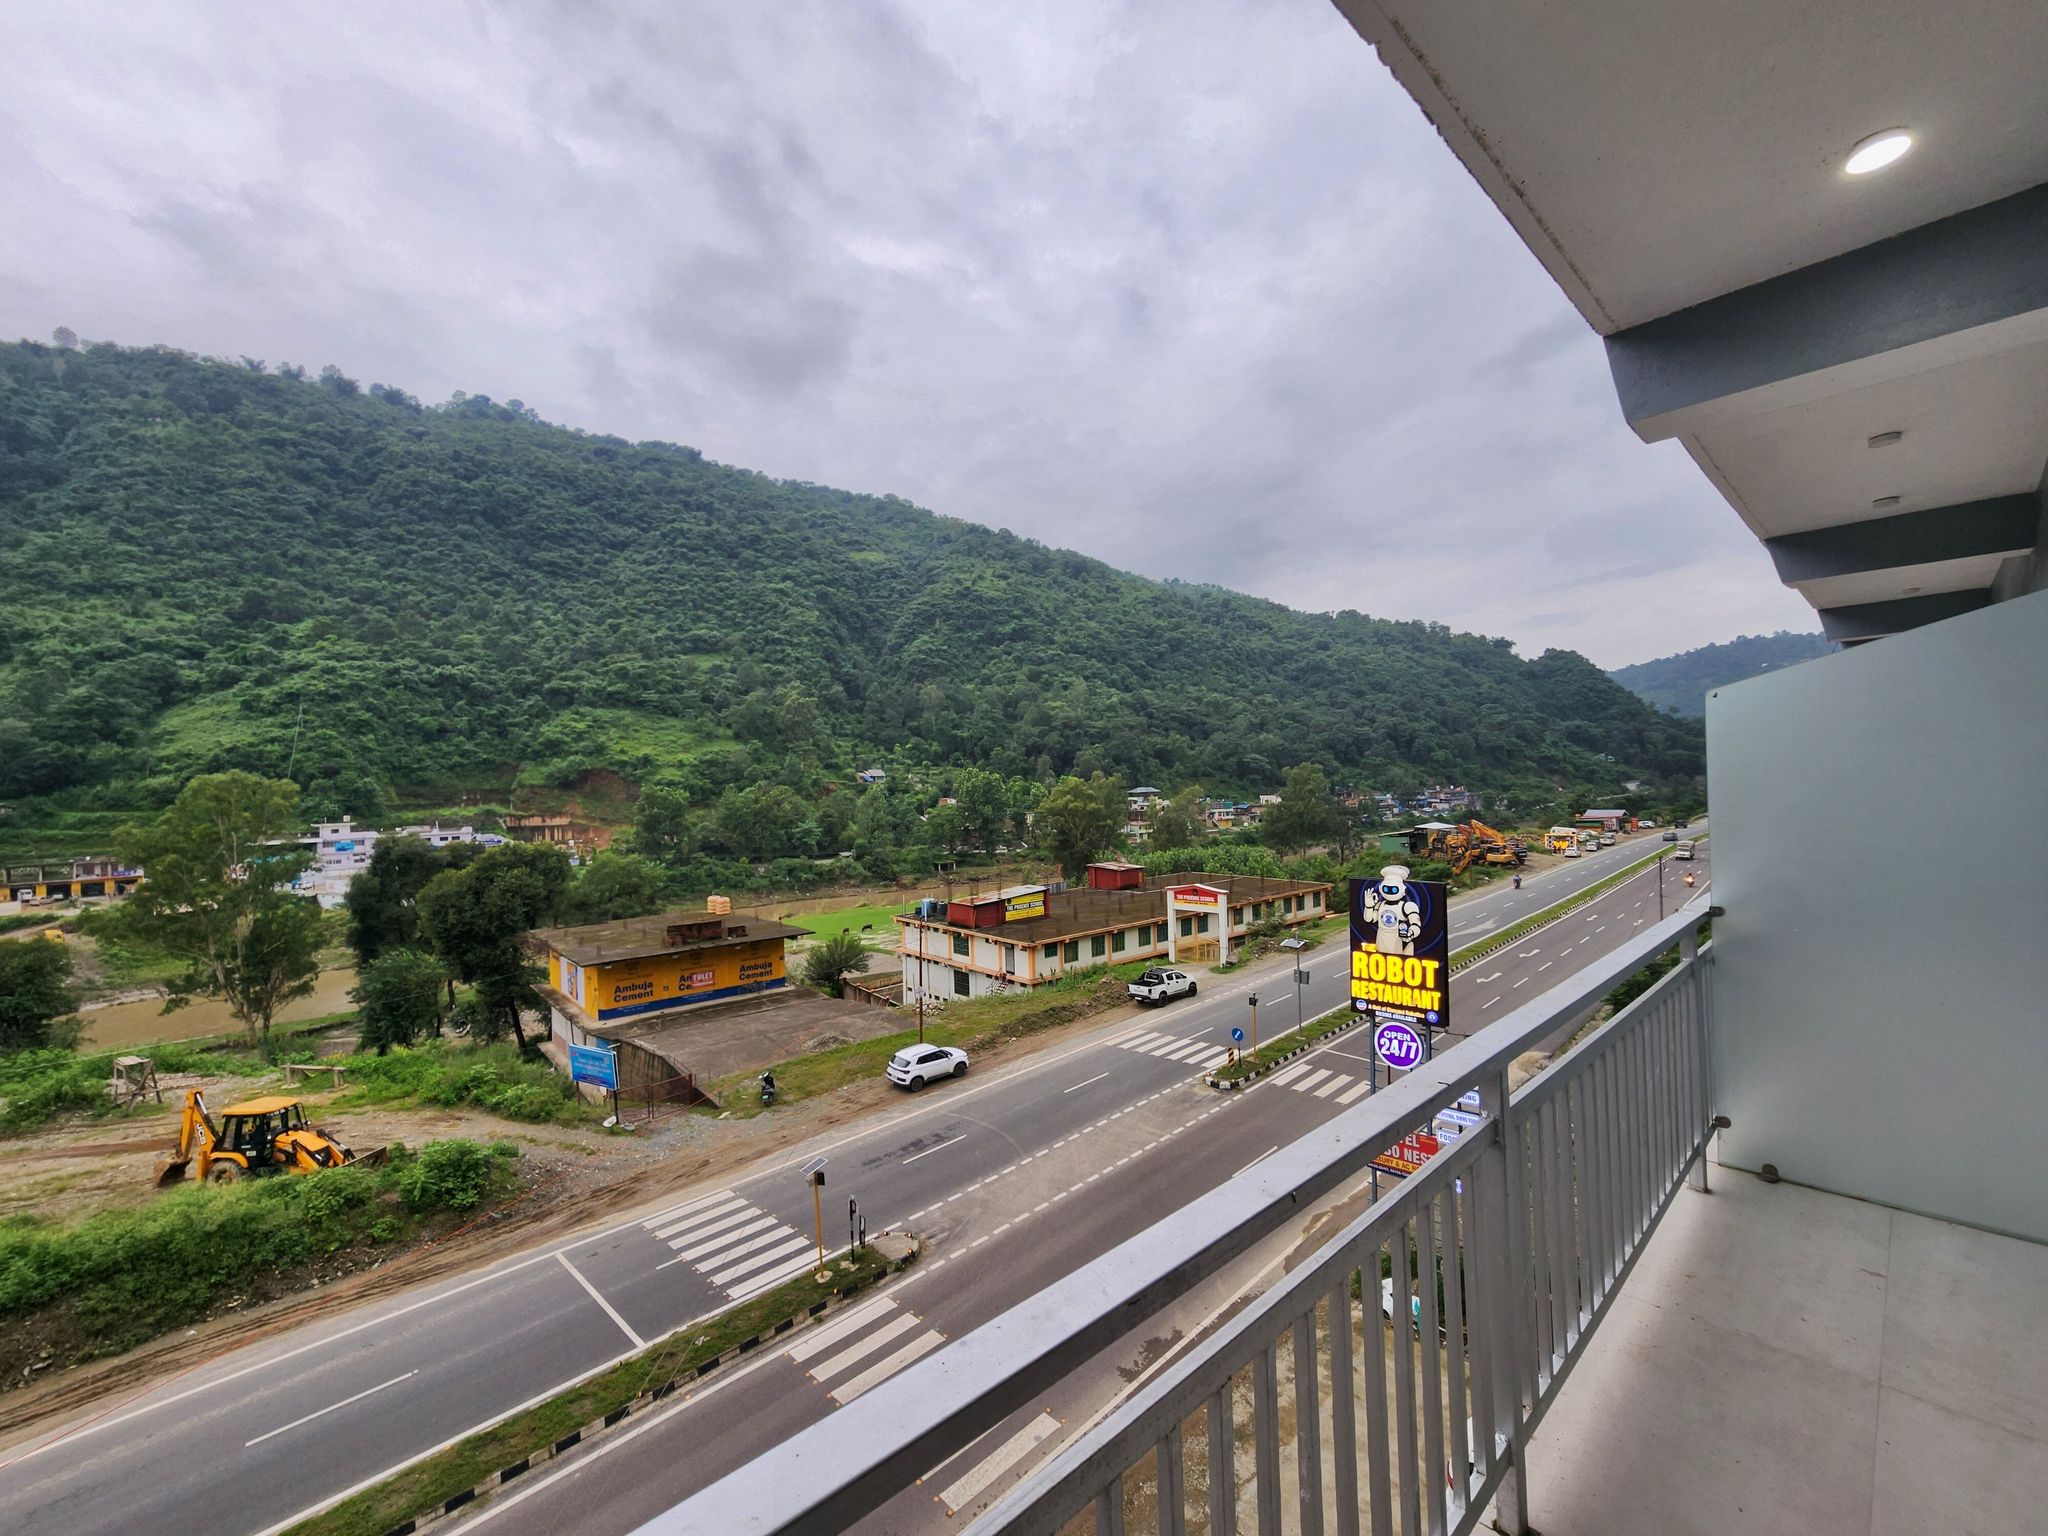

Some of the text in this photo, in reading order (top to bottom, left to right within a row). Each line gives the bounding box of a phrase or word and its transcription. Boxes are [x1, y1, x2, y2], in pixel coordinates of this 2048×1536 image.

[740, 962, 772, 972] Ambuja
[1352, 951, 1439, 988] ROBOT
[739, 970, 773, 981] Cement
[614, 981, 653, 994] Ambuja
[614, 990, 653, 1003] Cement
[1351, 979, 1441, 1011] RESTAURANT
[1384, 1031, 1410, 1041] OPEN
[1380, 1038, 1417, 1059] 24/7
